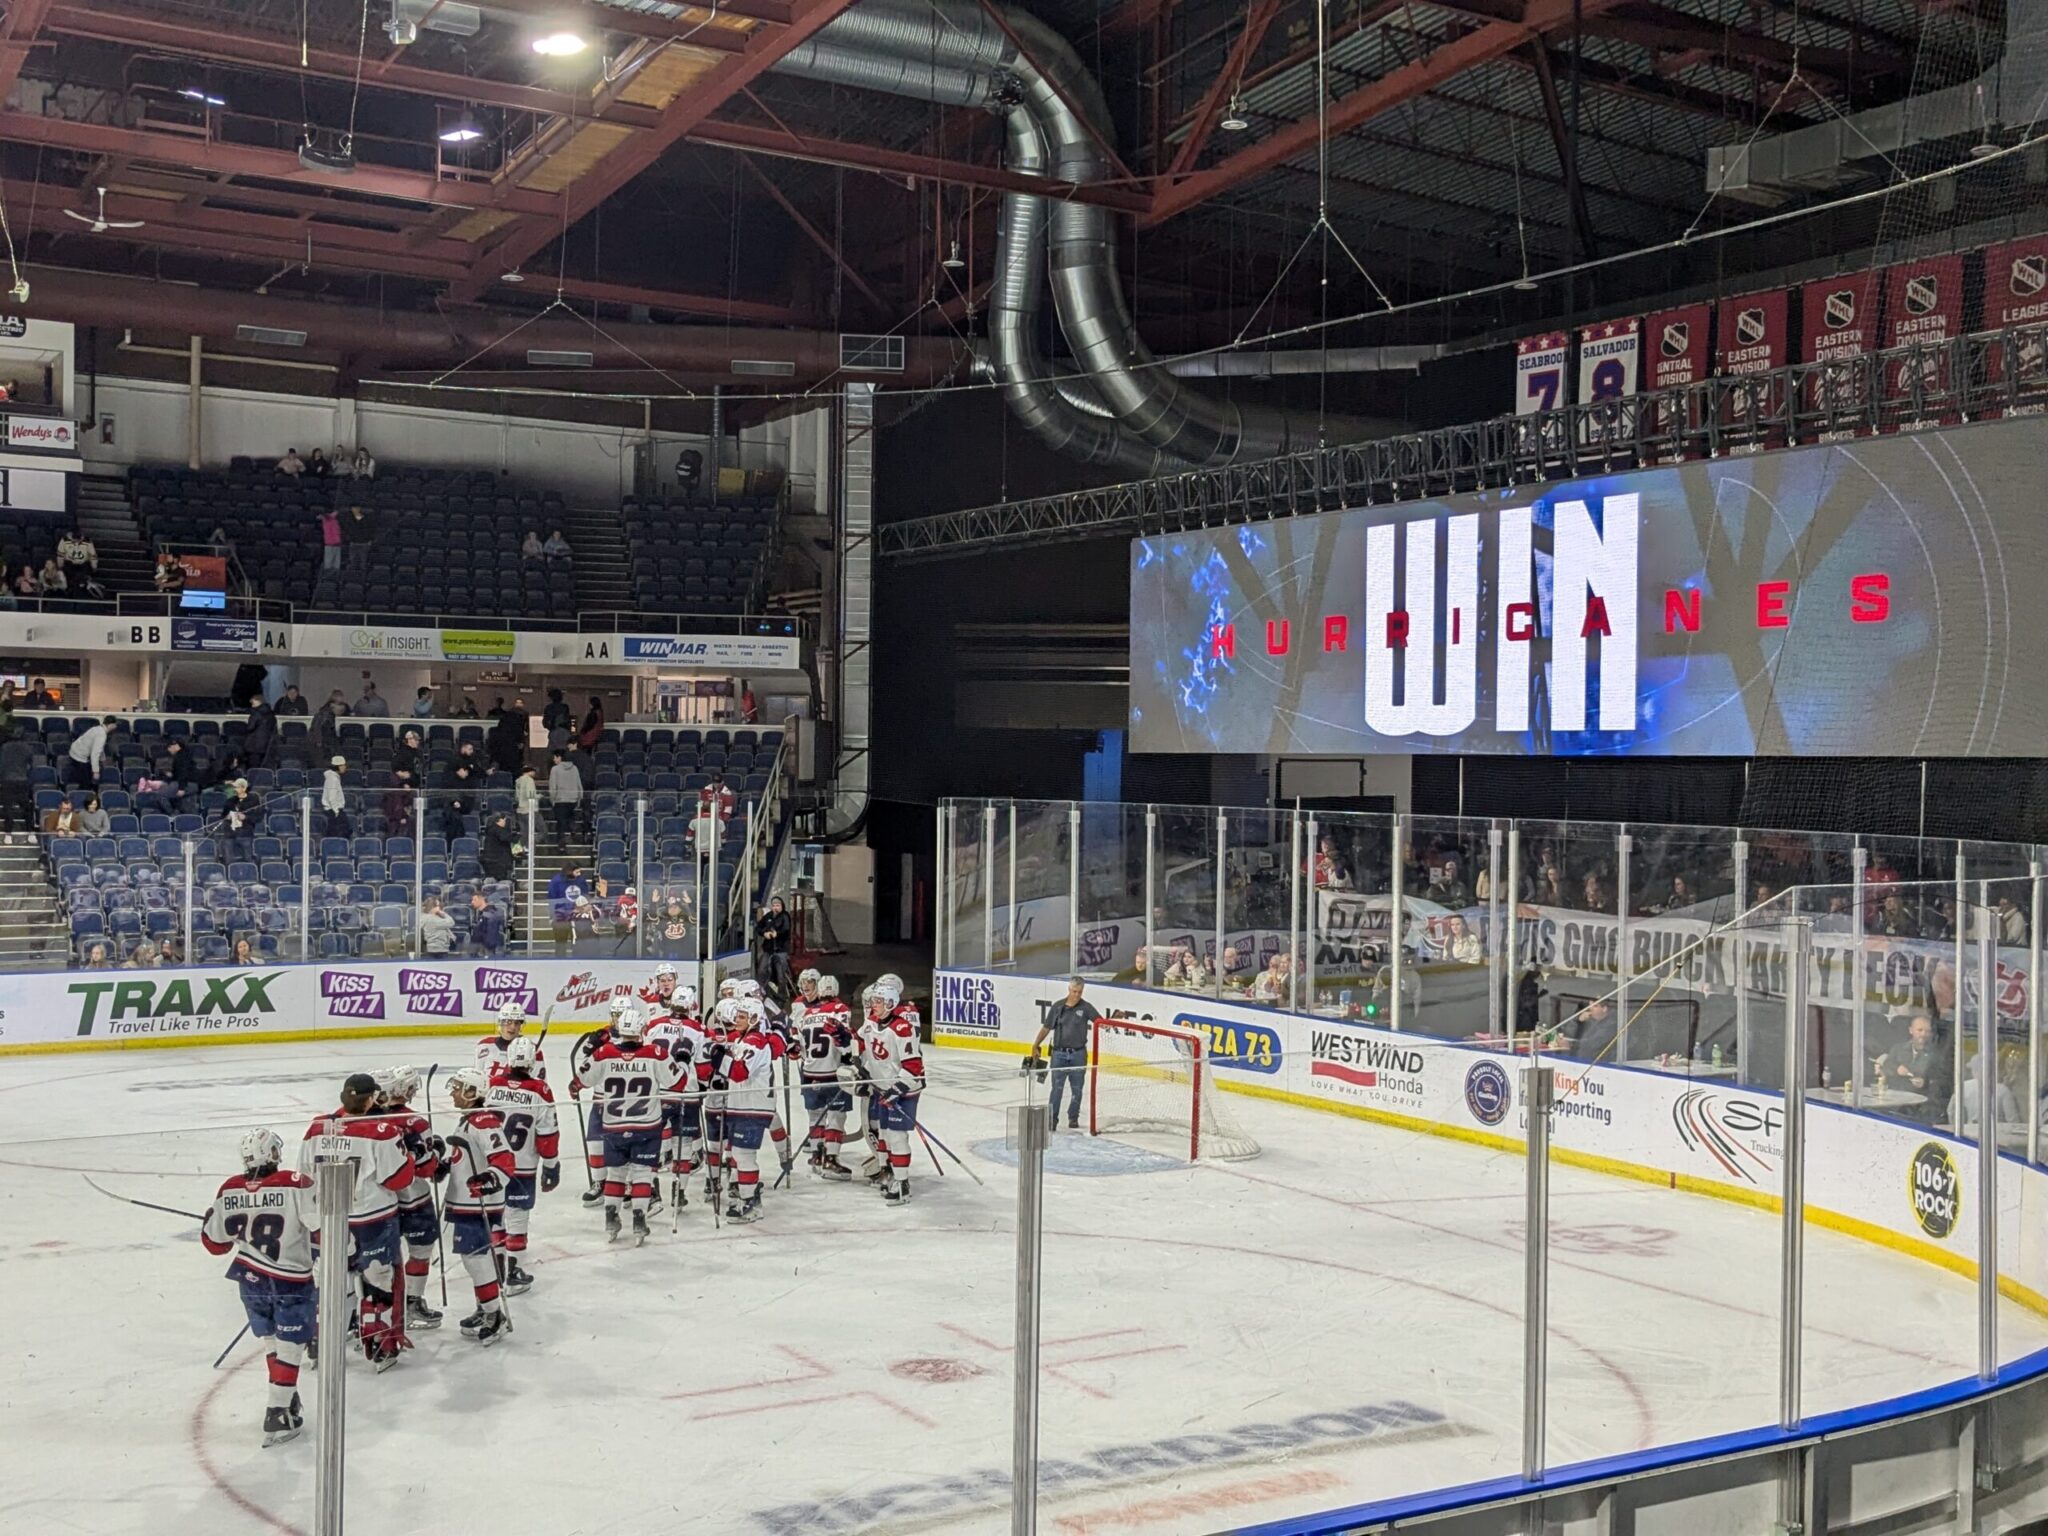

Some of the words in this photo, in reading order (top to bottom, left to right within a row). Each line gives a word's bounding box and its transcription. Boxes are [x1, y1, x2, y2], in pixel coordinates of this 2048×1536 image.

[1910, 283, 1934, 306] WHL
[1829, 299, 1852, 320] WHL
[1740, 317, 1764, 338] WHL
[1896, 315, 1946, 334] EASTERN
[1583, 337, 1636, 359] SALVADOR
[1667, 331, 1688, 350] WHL
[1815, 329, 1862, 348] EASTERN
[1896, 329, 1946, 348] DIVISION
[1519, 350, 1566, 370] SEABROO
[1728, 345, 1771, 363] EASTERN
[1816, 343, 1862, 361] DIVISION
[1728, 358, 1771, 374] DIVISION
[1527, 369, 1559, 412] 7
[1591, 358, 1625, 425] 8
[12, 424, 52, 441] Wendy's
[1212, 573, 1890, 660] HURRICANES
[1364, 492, 1640, 738] WIN
[386, 635, 430, 650] INSIGHT
[638, 641, 708, 657] WINMAR
[1633, 928, 1733, 982] BUICK
[562, 975, 598, 996] WHL
[67, 970, 292, 1036] TRAXX
[333, 992, 380, 1014] 107.7
[410, 990, 458, 1012] 107.7
[487, 990, 534, 1011] 1077
[574, 988, 612, 1011] LIVE
[615, 984, 633, 996] ON
[108, 1020, 155, 1034] Travel
[160, 1018, 190, 1032] Like
[196, 1016, 222, 1030] The
[227, 1015, 259, 1028] Pros
[946, 1028, 999, 1038] SPECIALISTS
[904, 1042, 913, 1055] 4
[1245, 1031, 1272, 1067] 73
[1311, 1030, 1424, 1074] WESTWIND
[610, 1062, 648, 1073] PAKKALA
[1378, 1071, 1423, 1095] Honda
[1582, 1076, 1604, 1097] You
[491, 1089, 533, 1105] JOHNSON
[604, 1076, 653, 1118] 22
[1311, 1080, 1334, 1091] LOVE
[1339, 1085, 1364, 1096] WHAT
[1369, 1091, 1387, 1102] YOU
[1392, 1095, 1423, 1109] DRIVE
[1552, 1097, 1611, 1126] upporting
[489, 1133, 503, 1149] 2
[1750, 1139, 1785, 1160] Trucking
[1914, 1161, 1956, 1196] 106.7
[224, 1192, 284, 1210] BRAILLARD
[1914, 1190, 1956, 1221] ROCK
[225, 1213, 285, 1262] 28
[362, 1246, 386, 1256] CCM
[277, 1324, 303, 1332] CCM
